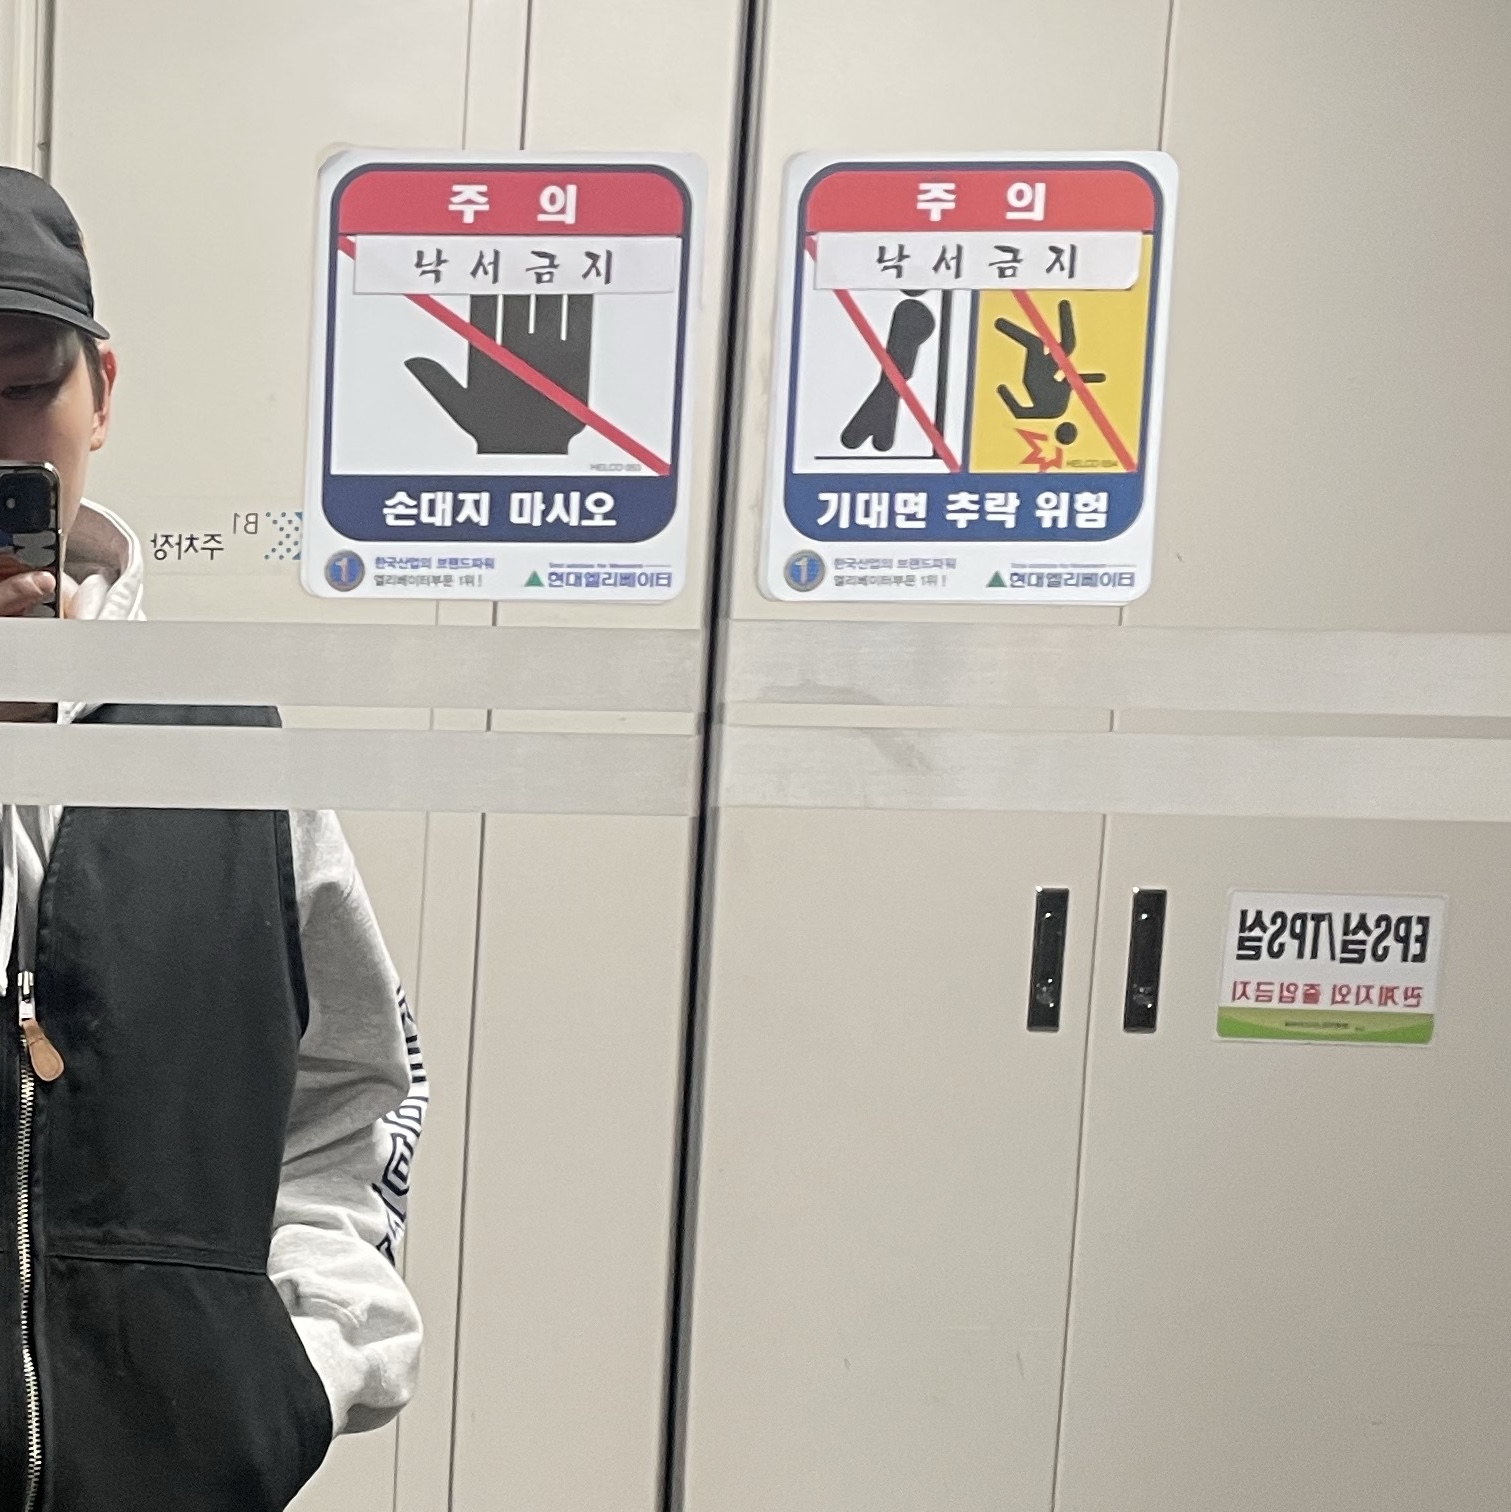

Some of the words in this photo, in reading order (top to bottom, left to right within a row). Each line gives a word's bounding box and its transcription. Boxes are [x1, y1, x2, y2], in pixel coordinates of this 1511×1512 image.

[382, 491, 490, 527] 손대지
[509, 490, 617, 527] 마시오
[817, 492, 929, 529] 기대면
[945, 492, 1021, 529] 추락
[1035, 491, 1109, 527] 위험
[548, 572, 673, 588] 현대엘리베이터
[1009, 571, 1136, 588] 현대엘리베이터
